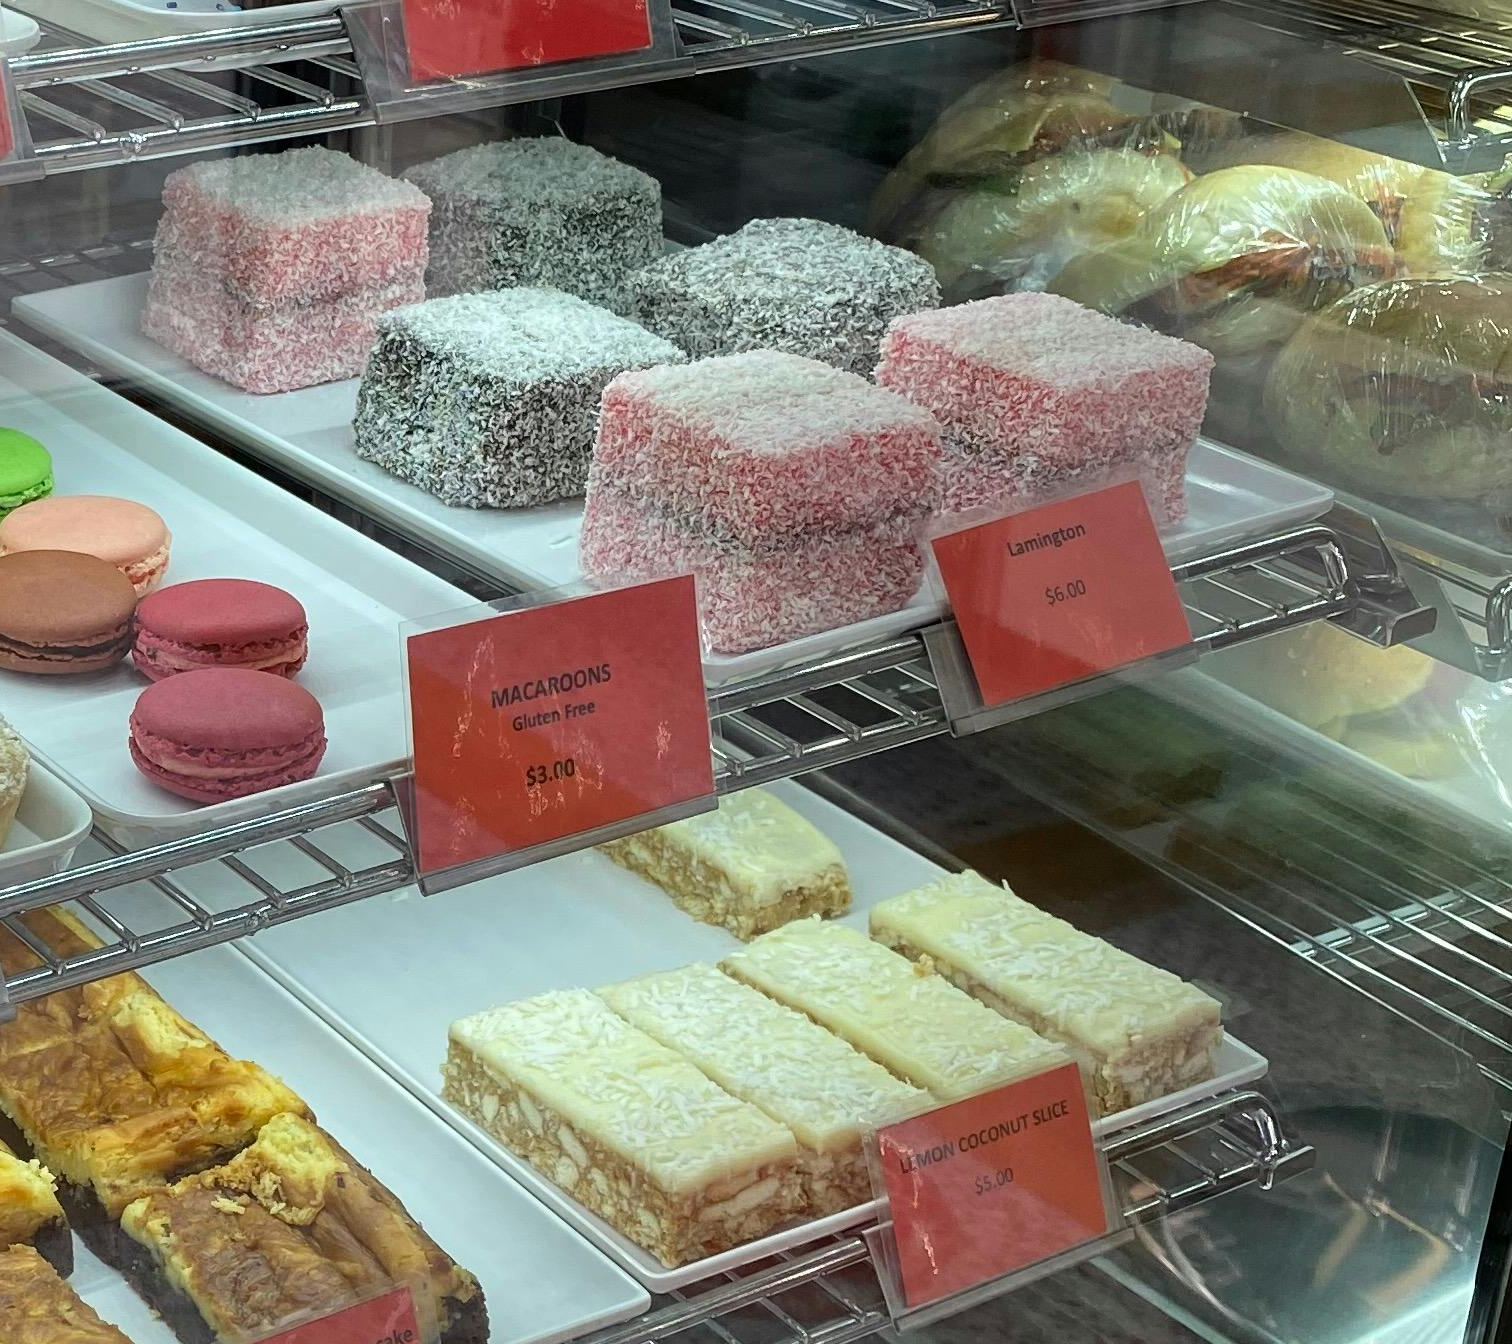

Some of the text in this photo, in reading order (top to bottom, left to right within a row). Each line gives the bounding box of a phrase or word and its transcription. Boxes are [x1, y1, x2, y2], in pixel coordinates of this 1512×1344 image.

[1006, 523, 1086, 557] Lamington
[1045, 579, 1086, 608] $6.00
[491, 664, 612, 709] MACAROONS
[512, 702, 595, 732] Gluten Free
[526, 758, 576, 787] $3.00
[957, 1113, 1029, 1153] COCONUT
[1031, 1099, 1070, 1127] SLICE
[974, 1167, 1014, 1196] $5.00
